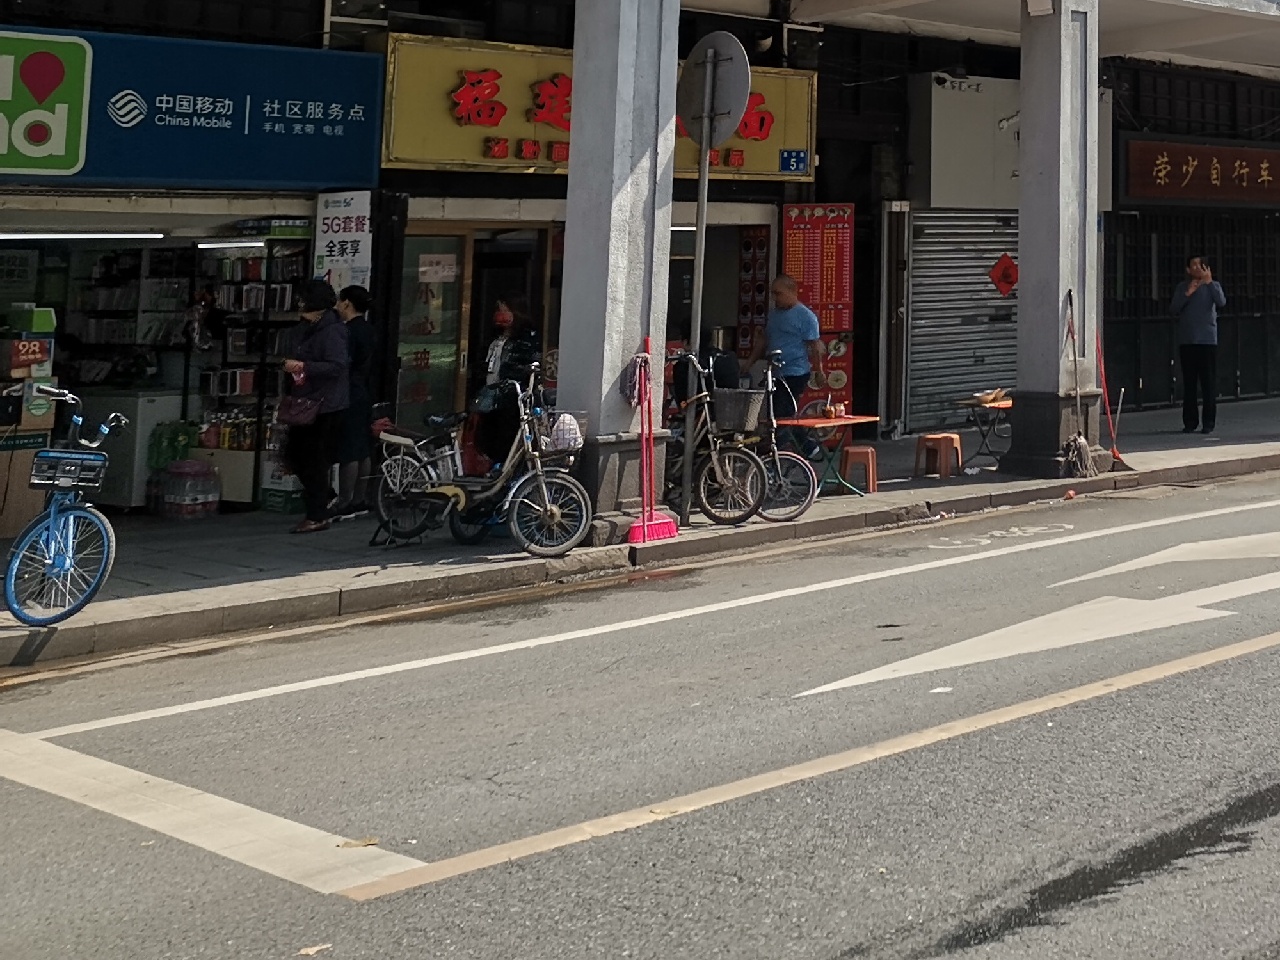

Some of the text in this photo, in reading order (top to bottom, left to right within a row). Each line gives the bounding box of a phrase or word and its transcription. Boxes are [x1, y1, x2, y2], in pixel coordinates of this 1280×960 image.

[155, 93, 234, 116] 中国移动
[262, 99, 365, 122] 社区服务点
[154, 114, 233, 129] China Mobile
[262, 122, 344, 136] 手机 宽带 电视
[321, 215, 367, 234] 5G套餐
[325, 239, 361, 258] 全家享
